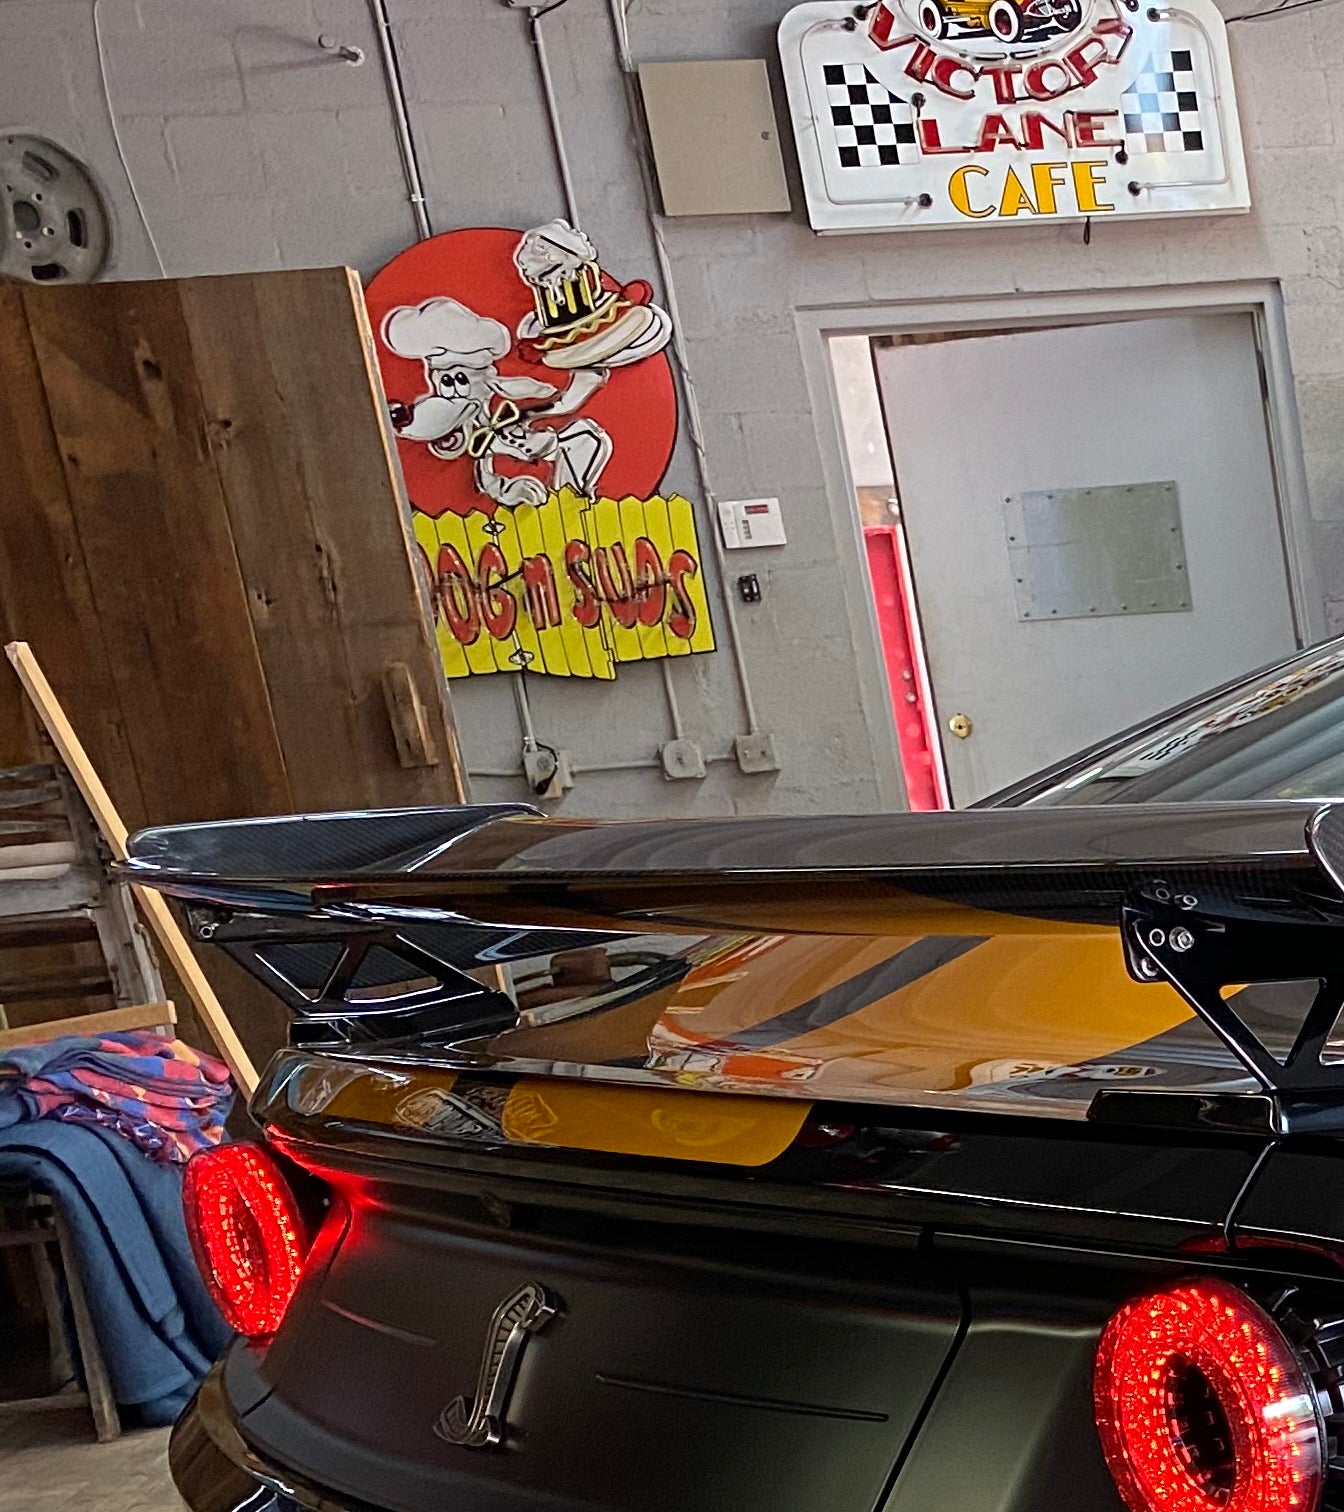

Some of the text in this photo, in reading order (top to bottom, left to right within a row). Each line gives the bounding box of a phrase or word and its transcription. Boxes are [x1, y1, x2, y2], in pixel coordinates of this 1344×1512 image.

[868, 0, 1133, 104] VICTORY
[917, 109, 1123, 154] LANE
[948, 161, 1115, 218] CAFE
[521, 553, 562, 630] n
[565, 537, 698, 640] SUDS
